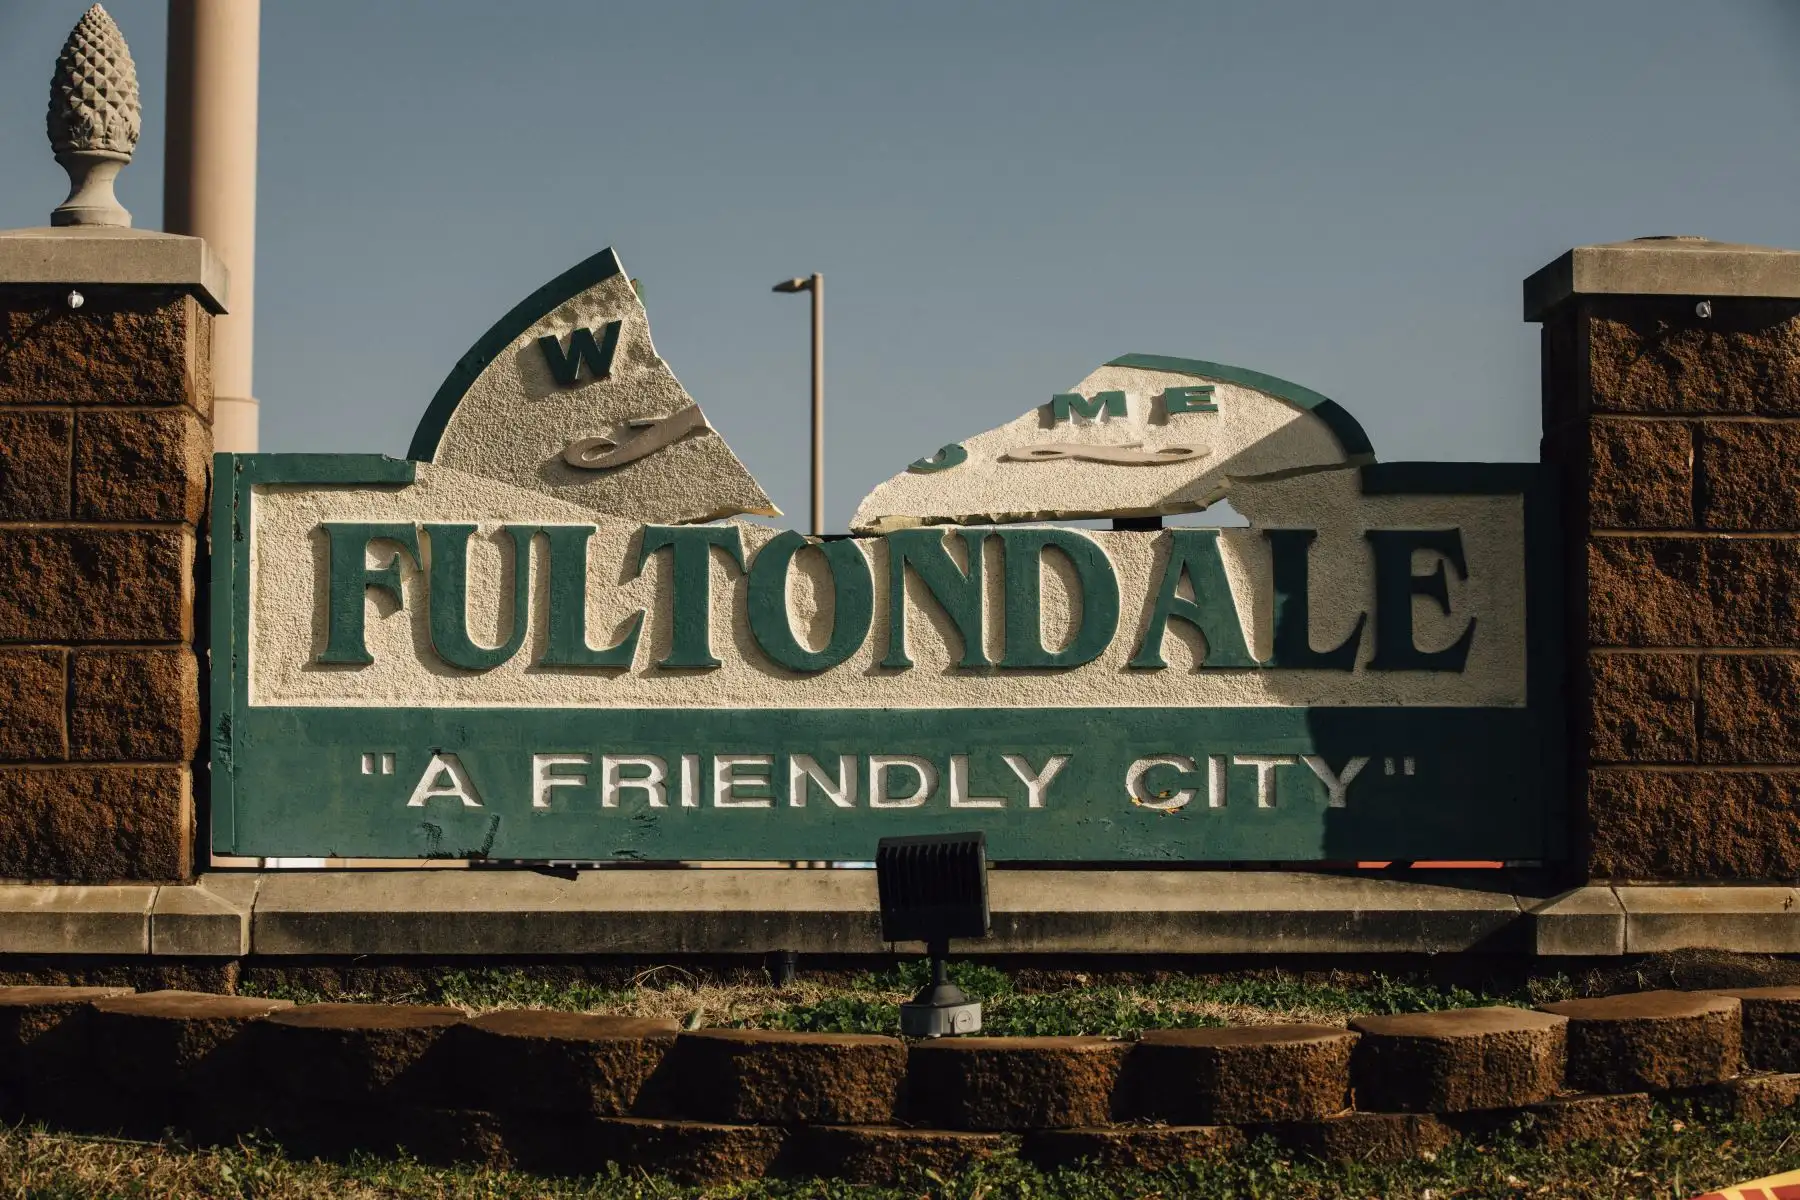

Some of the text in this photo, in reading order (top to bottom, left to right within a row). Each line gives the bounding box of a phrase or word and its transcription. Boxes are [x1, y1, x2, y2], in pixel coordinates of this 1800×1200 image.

[316, 523, 1477, 673] FULTONDALE
[361, 752, 1416, 809] "A FRIENDLY CITY"
